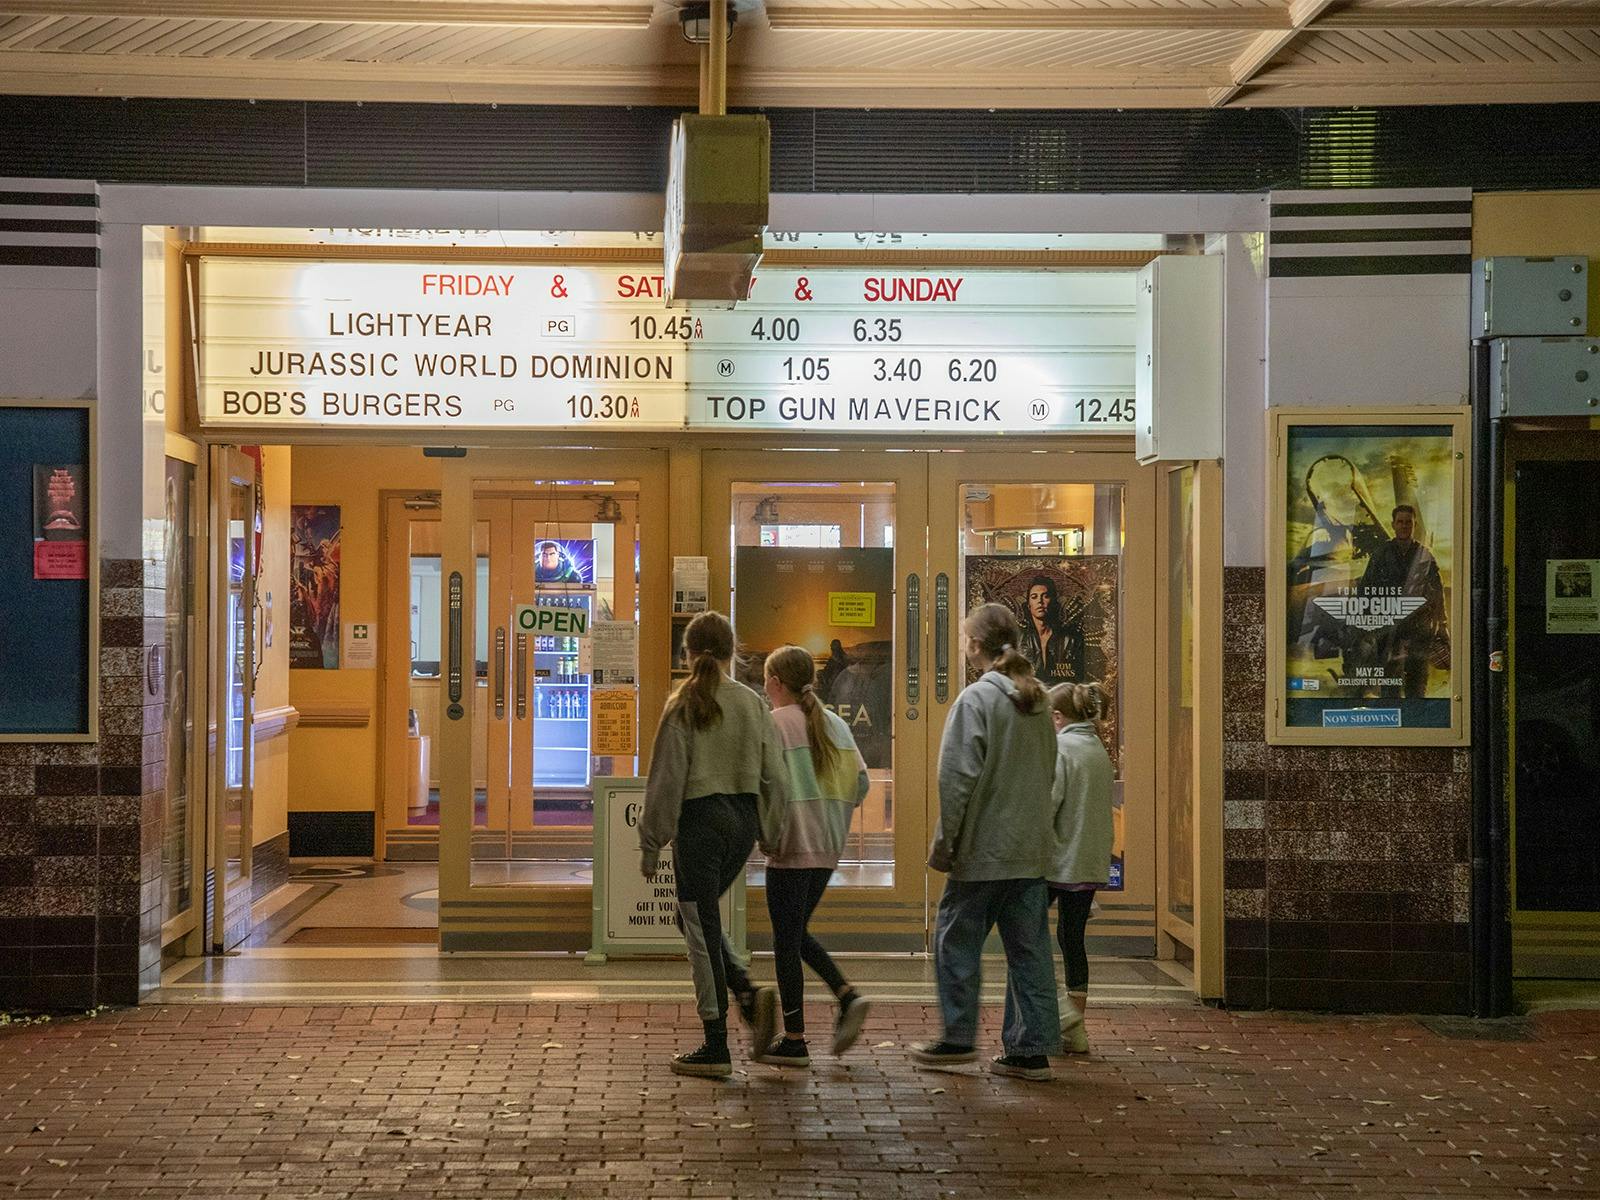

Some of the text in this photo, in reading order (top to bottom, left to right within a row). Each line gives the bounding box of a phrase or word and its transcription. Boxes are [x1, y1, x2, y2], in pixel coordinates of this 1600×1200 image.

[422, 274, 513, 297] FRIDAY
[550, 275, 568, 298] &
[794, 277, 812, 300] &
[865, 278, 963, 301] SUNDAY
[329, 313, 492, 337] LIGHTYEAR
[548, 320, 569, 332] PG
[630, 316, 692, 340] 10.45
[751, 317, 800, 341] 4.00
[853, 318, 902, 341] 6.35
[249, 351, 398, 377] JURASSIC
[414, 353, 518, 378] WORLD
[531, 355, 673, 380] DOMINION
[783, 357, 830, 381] 1.05
[873, 358, 922, 382] 3.40
[948, 359, 997, 382] 6.20
[223, 390, 307, 416] BOB'S
[323, 392, 463, 418] BURGERS
[494, 399, 515, 412] PG
[566, 395, 628, 418] 10.30
[706, 396, 766, 421] TOP
[778, 396, 836, 421] GUN
[848, 397, 1001, 422] MAVERICK
[1075, 398, 1136, 422] 12.45
[1337, 586, 1403, 596] TOM CRUISE
[519, 608, 586, 634] OPEN
[1345, 614, 1395, 626] MAVERICK
[1355, 667, 1385, 677] MAY 26
[1338, 678, 1403, 686] EXCLUSIVE TO CINEMAS
[1324, 714, 1399, 724] NOW SHOWING
[636, 901, 656, 912] GIFT
[628, 915, 656, 926] MOVIE
